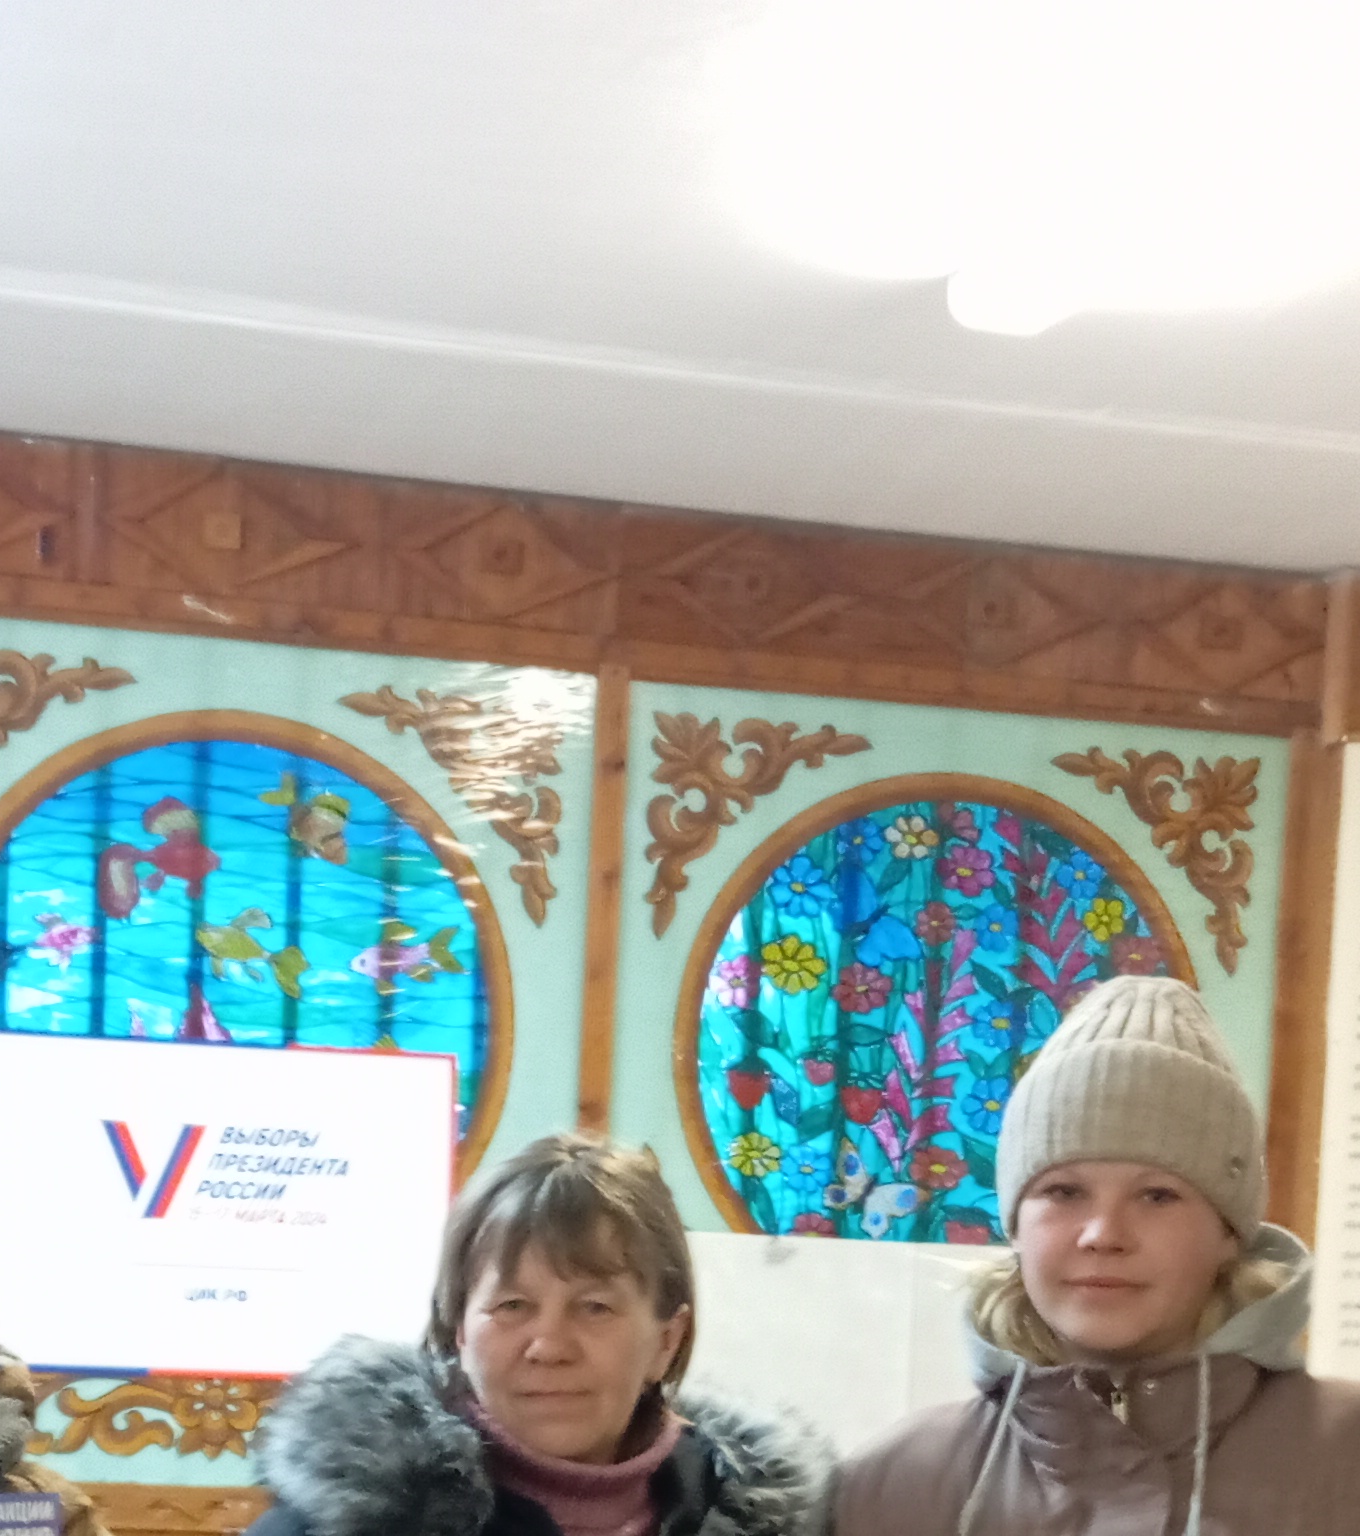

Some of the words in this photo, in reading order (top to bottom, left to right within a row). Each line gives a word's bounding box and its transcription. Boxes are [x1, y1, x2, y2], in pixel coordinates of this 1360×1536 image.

[219, 1126, 321, 1148] ВЫБОРЫ
[207, 1152, 350, 1177] ПРЕЗИДЕНТА
[195, 1179, 288, 1200] РОССИИ
